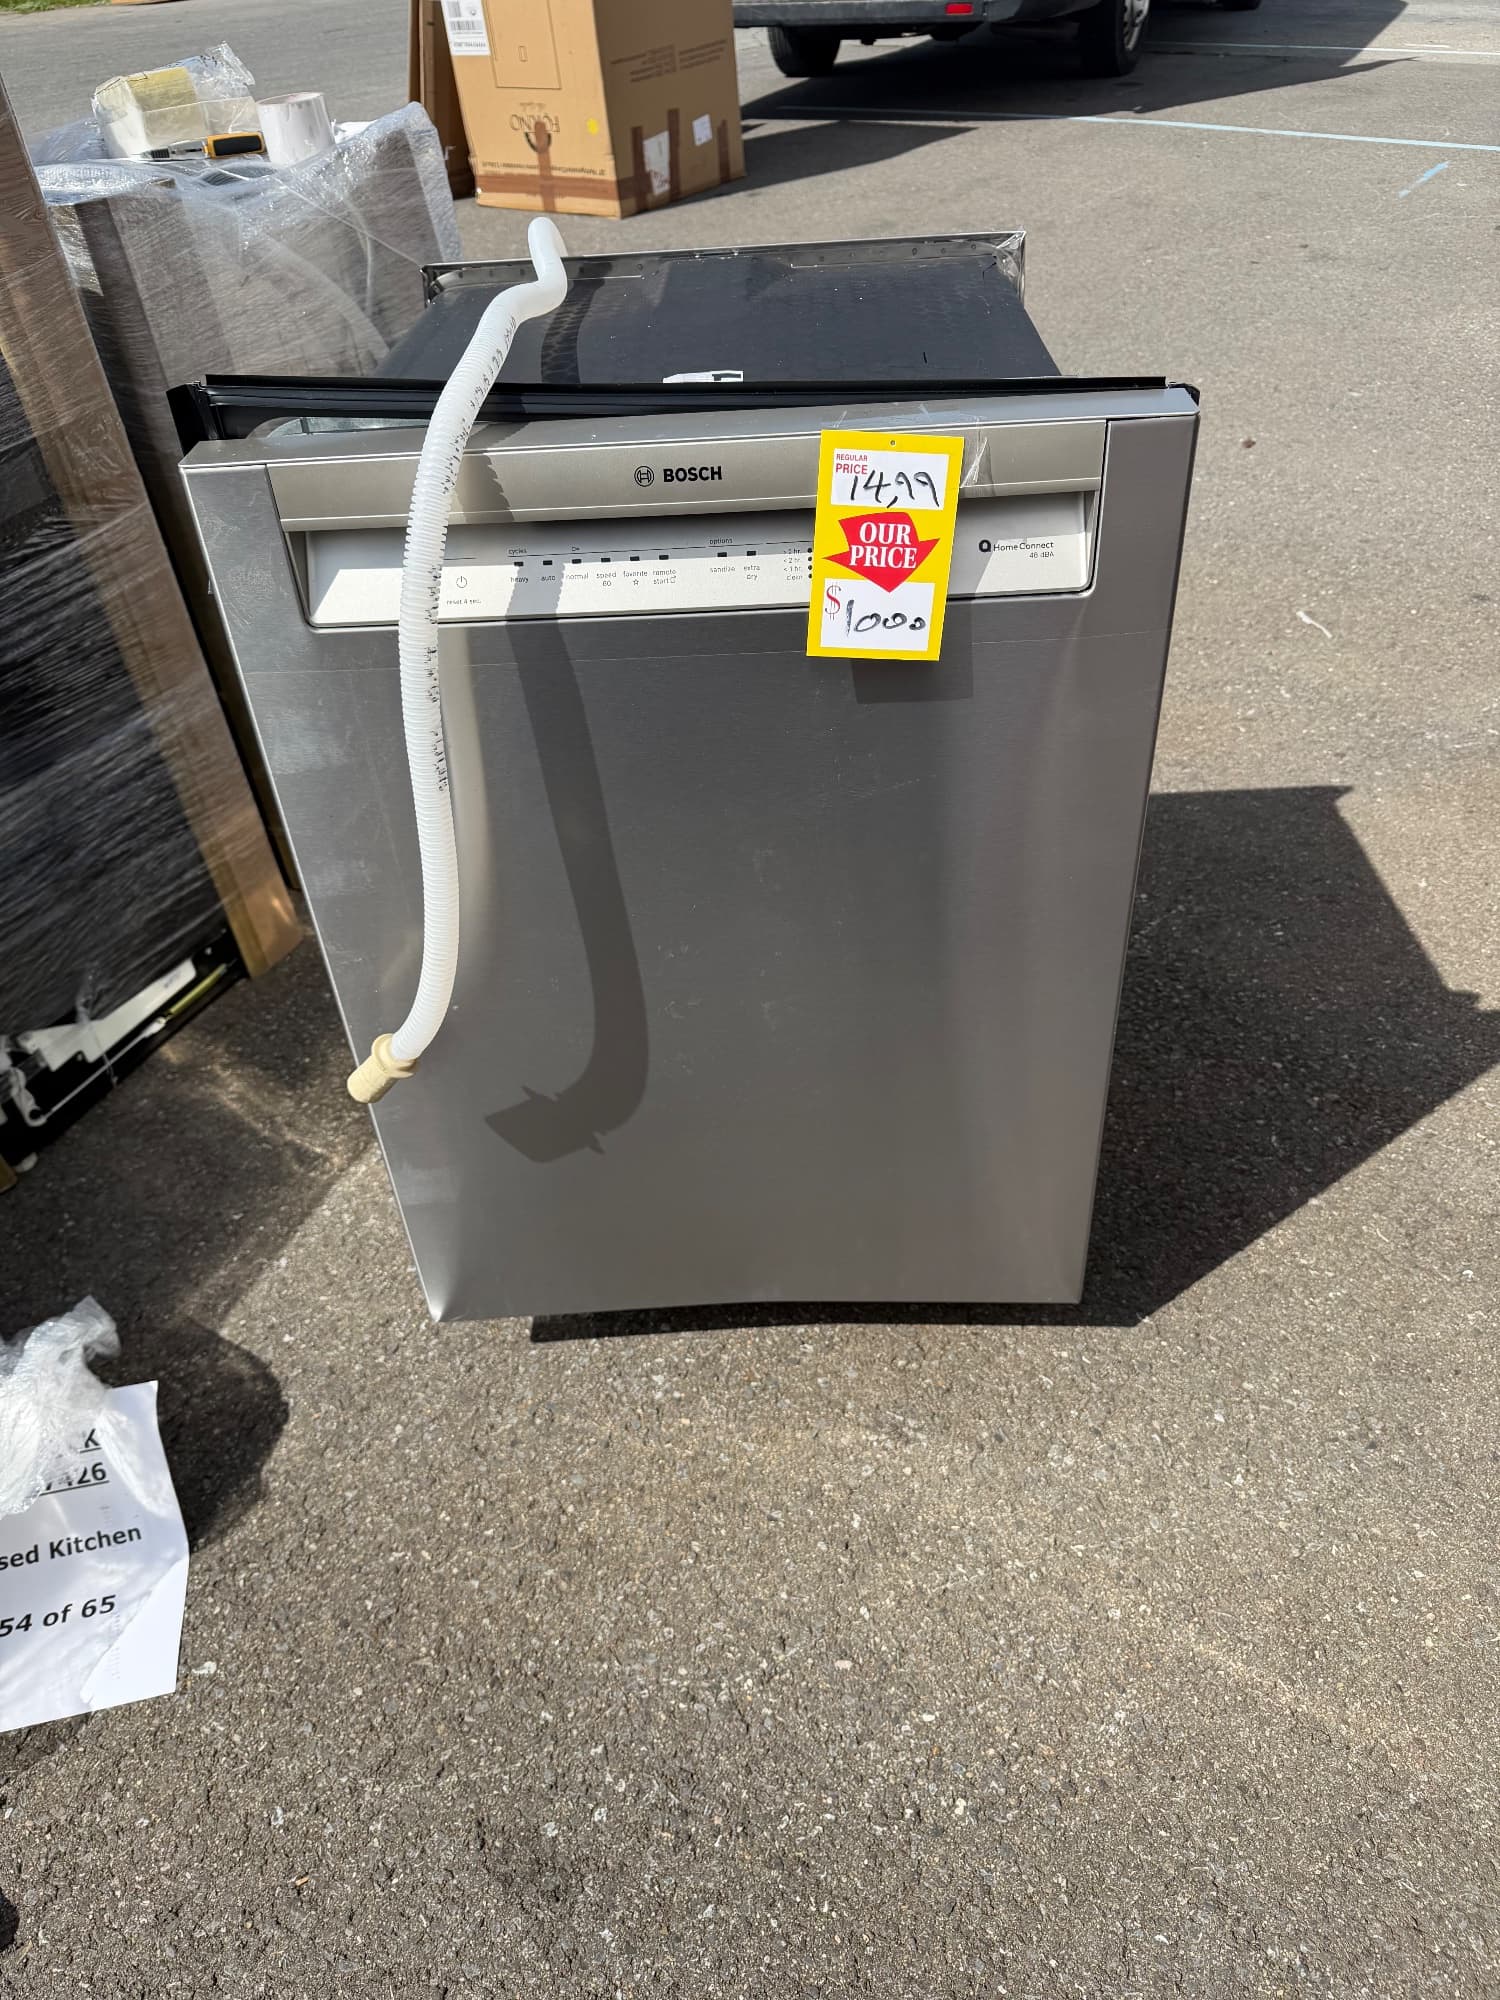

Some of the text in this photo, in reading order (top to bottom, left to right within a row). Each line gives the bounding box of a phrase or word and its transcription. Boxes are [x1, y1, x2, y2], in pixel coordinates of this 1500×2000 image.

[836, 453, 868, 462] REGULAR
[835, 463, 868, 475] PRICE
[663, 466, 723, 483] BOSCH
[859, 521, 911, 546] OUR
[709, 537, 733, 546] options
[508, 547, 527, 555] cycles
[993, 541, 1054, 552] Home Connect
[849, 545, 918, 570] PRICE
[623, 569, 648, 578] favorite
[652, 569, 676, 577] remote
[710, 565, 736, 573] sanitize
[566, 572, 589, 580] normal
[596, 571, 617, 579] speed
[510, 576, 529, 584] heavy
[653, 577, 669, 585] start
[49, 1527, 142, 1560] Kitchen
[43, 1603, 73, 1627] of
[81, 1594, 117, 1619] 65
